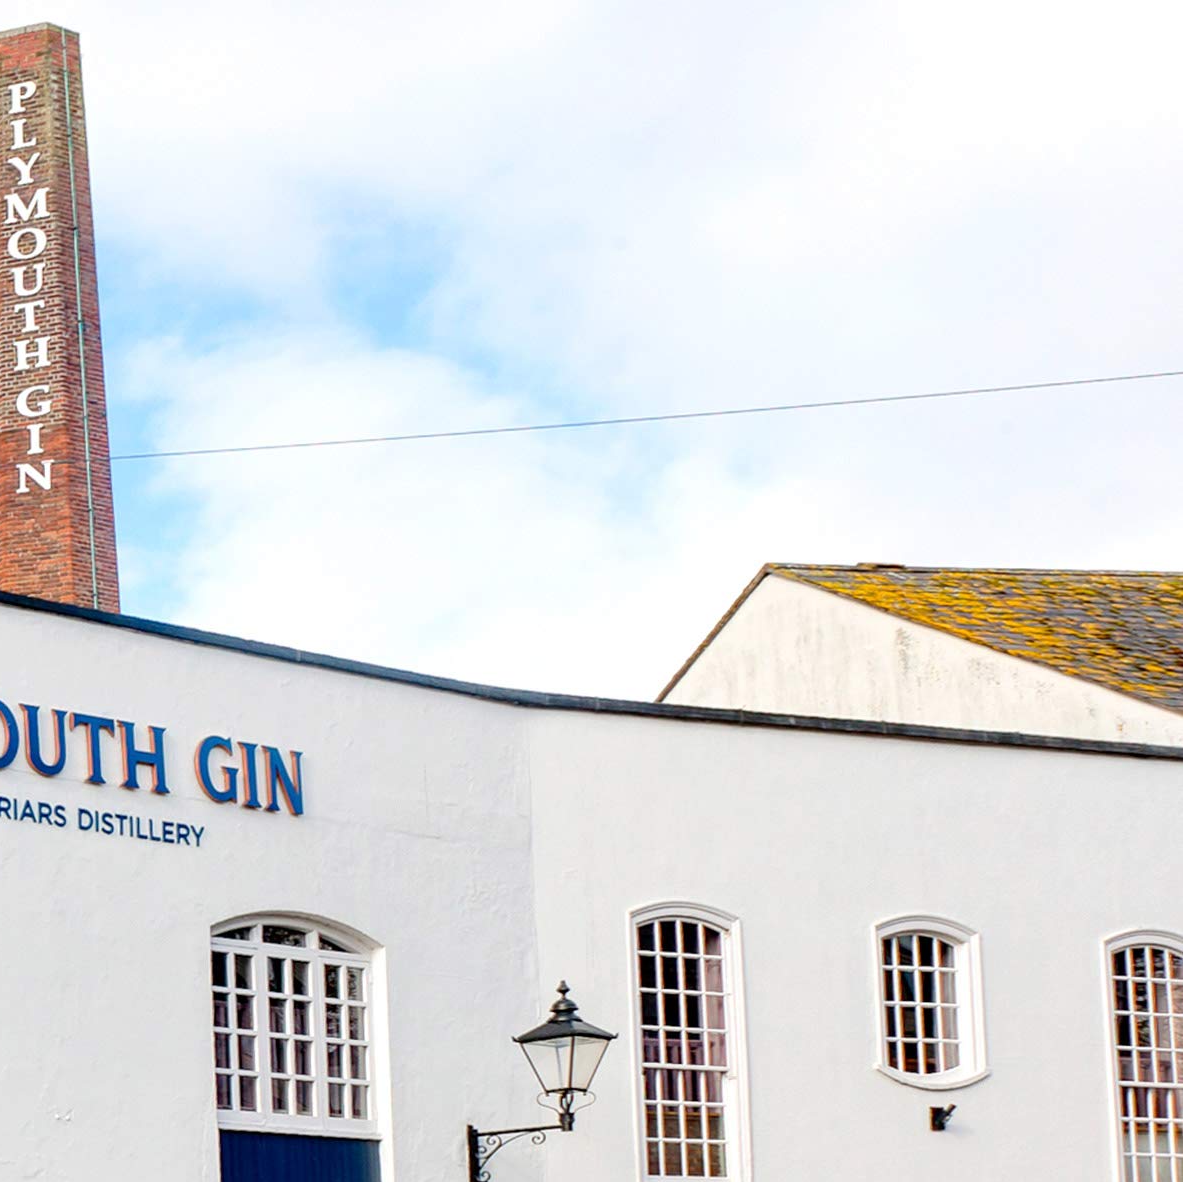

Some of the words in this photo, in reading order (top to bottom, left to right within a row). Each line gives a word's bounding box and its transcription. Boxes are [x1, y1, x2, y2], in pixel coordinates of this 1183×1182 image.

[3, 81, 50, 372] PLYMOUTH
[16, 384, 55, 494] GIN
[194, 736, 305, 816] GIN
[77, 808, 205, 848] DISTILLERY
